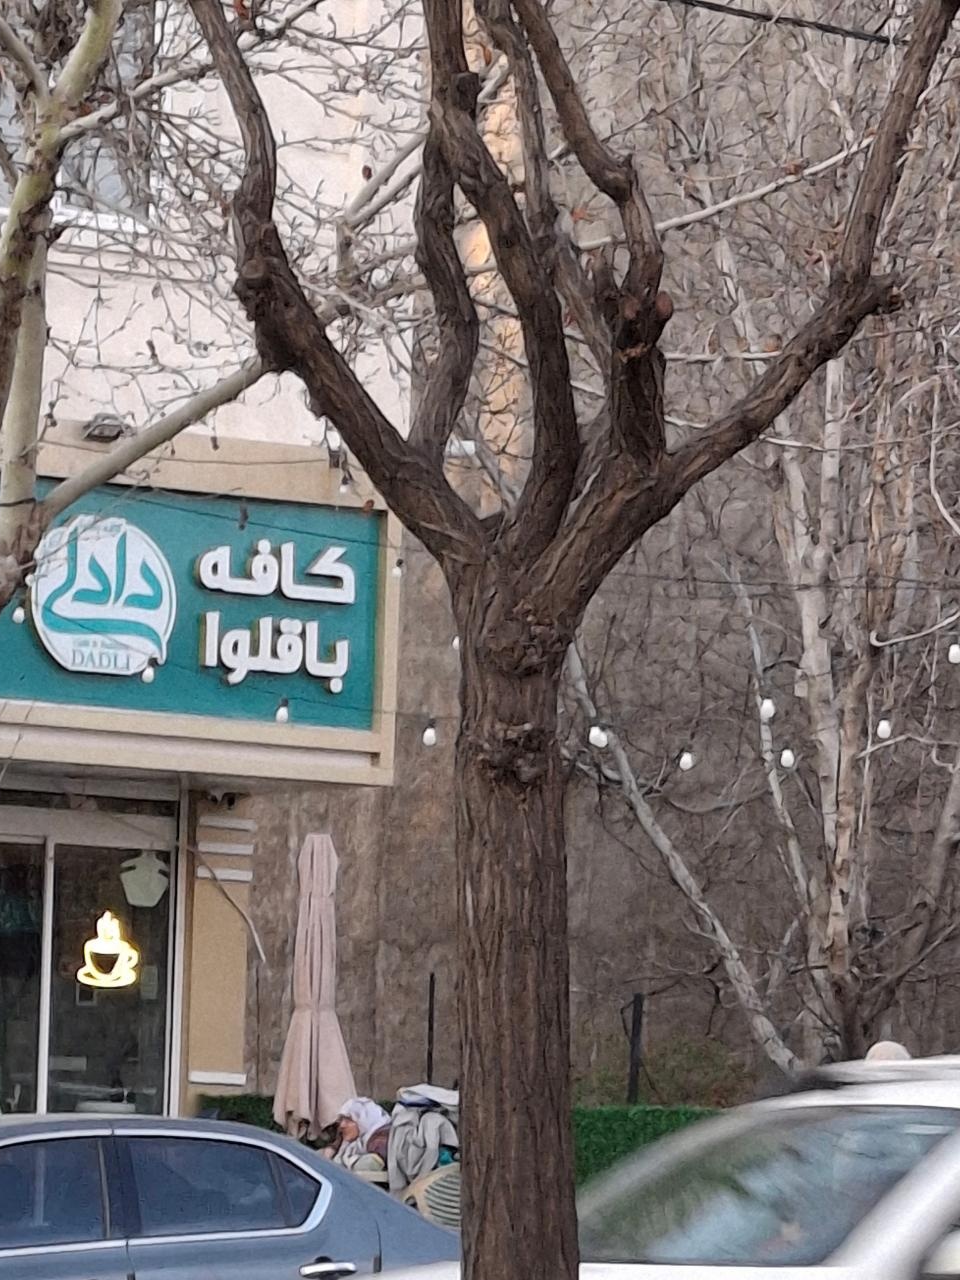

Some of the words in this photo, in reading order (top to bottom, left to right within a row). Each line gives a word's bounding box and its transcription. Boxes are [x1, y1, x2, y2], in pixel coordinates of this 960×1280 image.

[199, 538, 355, 604] کافه
[71, 648, 131, 671] DADLI
[204, 610, 349, 694] باقلوا
